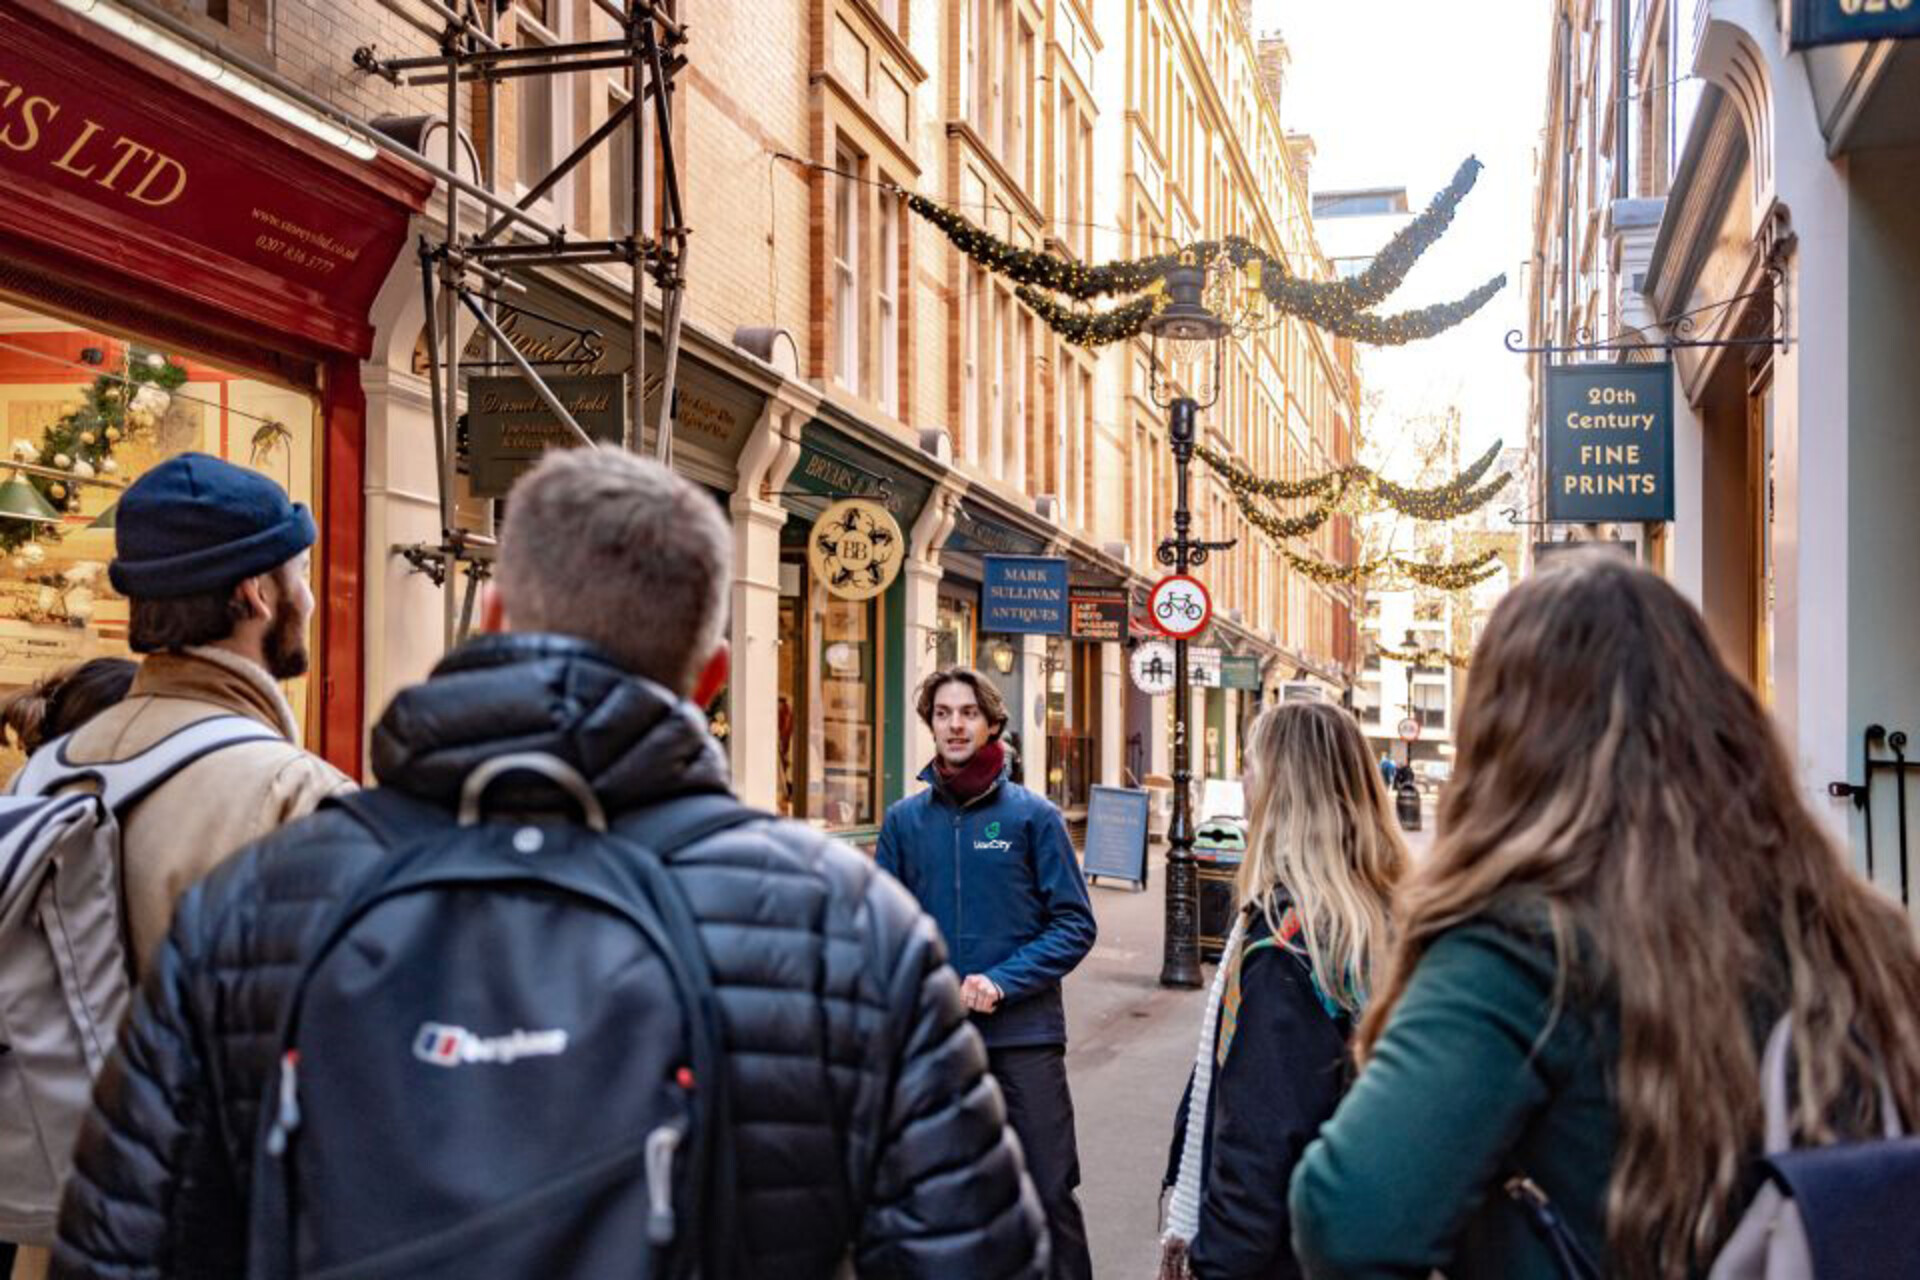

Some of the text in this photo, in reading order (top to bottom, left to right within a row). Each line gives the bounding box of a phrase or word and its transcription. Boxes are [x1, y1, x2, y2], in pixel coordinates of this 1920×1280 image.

[0, 79, 187, 206] 'S LTD
[1588, 387, 1636, 404] 20th
[1567, 411, 1655, 431] Century
[1581, 445, 1640, 465] FINE
[1565, 474, 1656, 495] PRINTS
[1004, 568, 1048, 582] MARK
[990, 585, 1061, 601] SULLIVAN
[991, 607, 1059, 622] ANTIQUES
